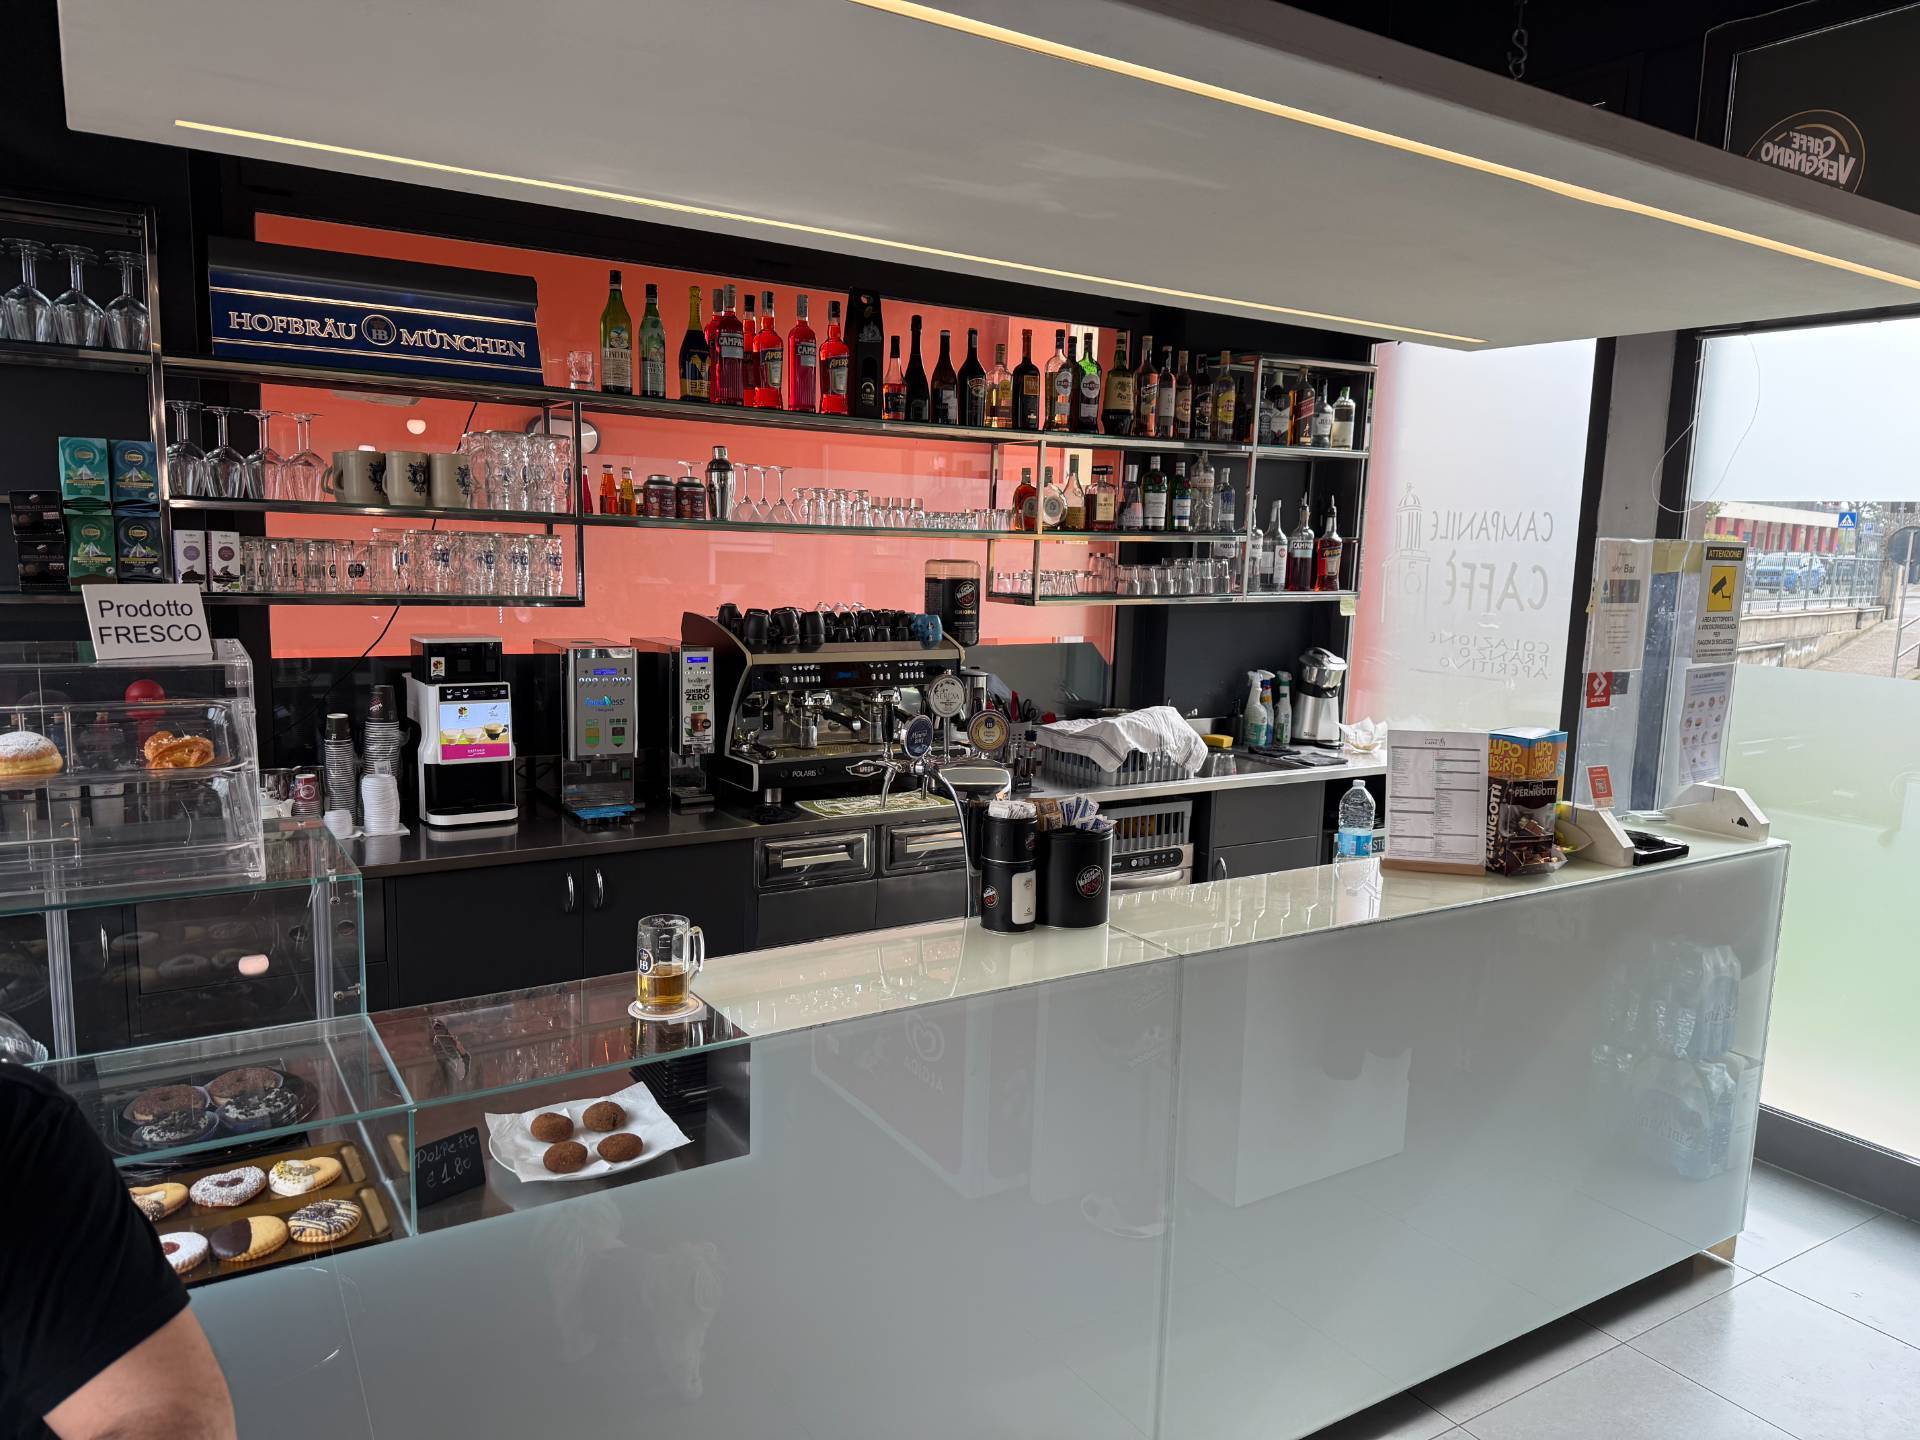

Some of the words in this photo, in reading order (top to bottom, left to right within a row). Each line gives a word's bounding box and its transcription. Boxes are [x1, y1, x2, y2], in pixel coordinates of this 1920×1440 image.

[229, 311, 356, 340] HOFBRÄU
[400, 328, 526, 358] MÜNCHEN
[719, 337, 744, 346] CAMPA
[98, 599, 193, 618] Prodotto
[98, 623, 202, 645] FRESCO
[687, 693, 710, 701] ZERO
[792, 769, 817, 777] POLARIS
[1514, 786, 1556, 798] PERNIGOTTI
